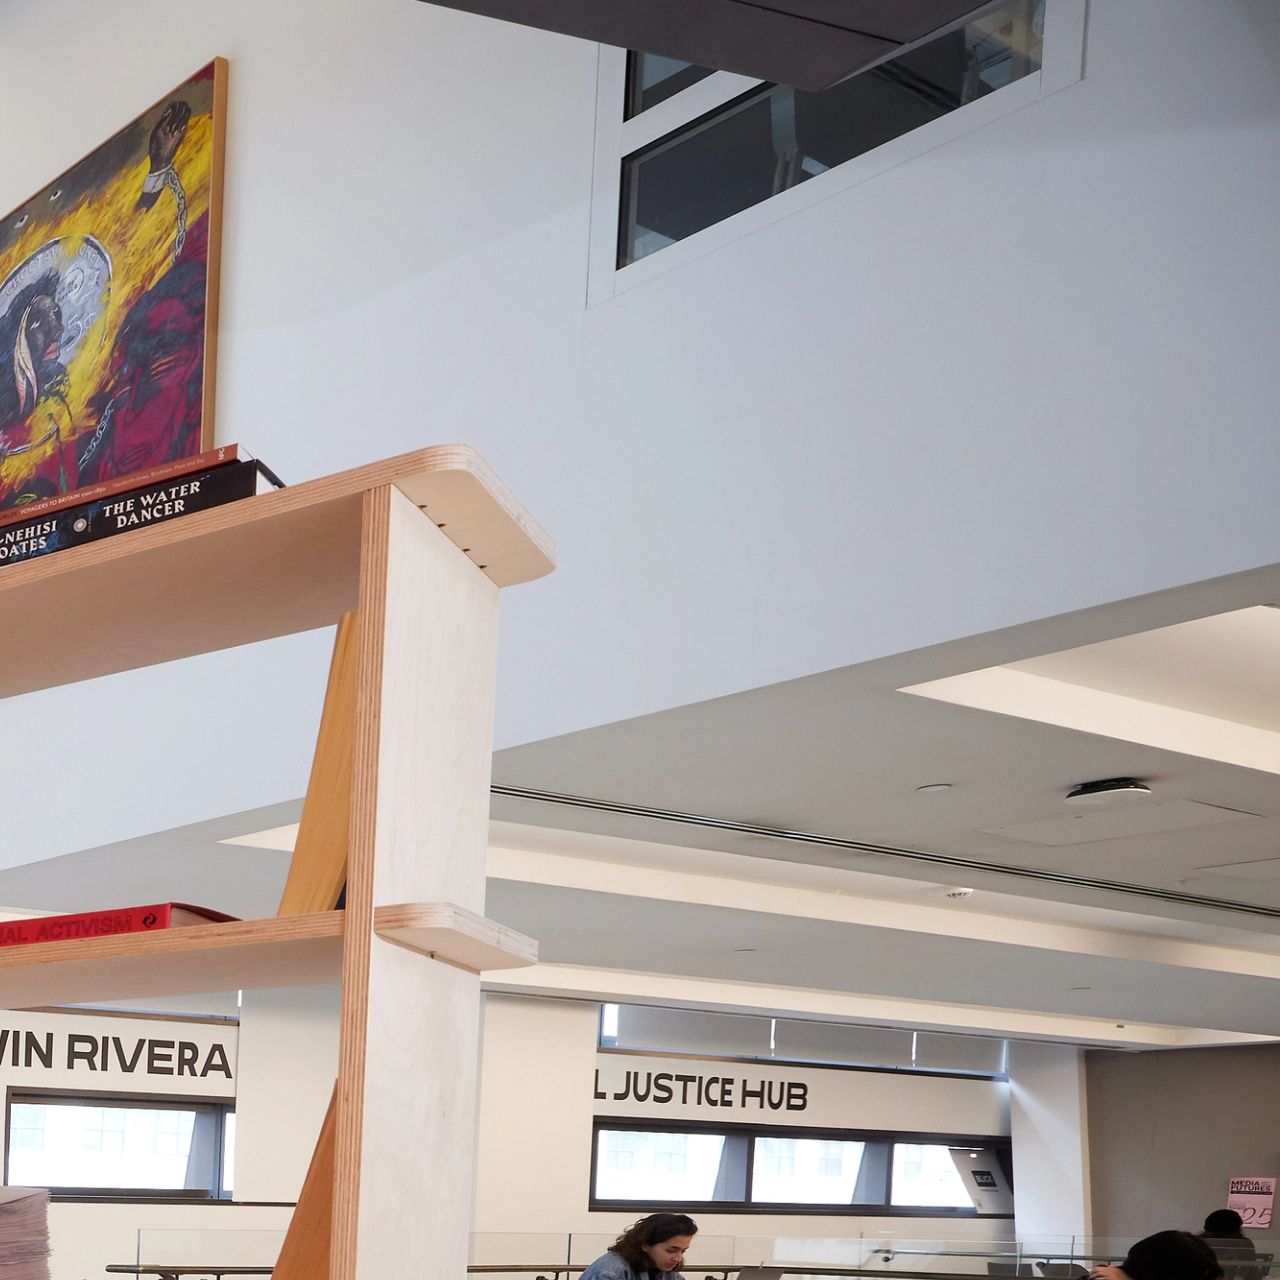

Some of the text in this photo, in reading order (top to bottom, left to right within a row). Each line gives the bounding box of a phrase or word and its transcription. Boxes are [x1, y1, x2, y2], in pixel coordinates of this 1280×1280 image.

[103, 480, 201, 519] THE WATER
[116, 499, 185, 529] DANCER
[37, 914, 133, 942] ACTIVISM
[66, 1033, 233, 1079] RIVERA
[594, 1069, 809, 1111] L JUSTICE HUB
[1230, 1180, 1260, 1188] MEDIA
